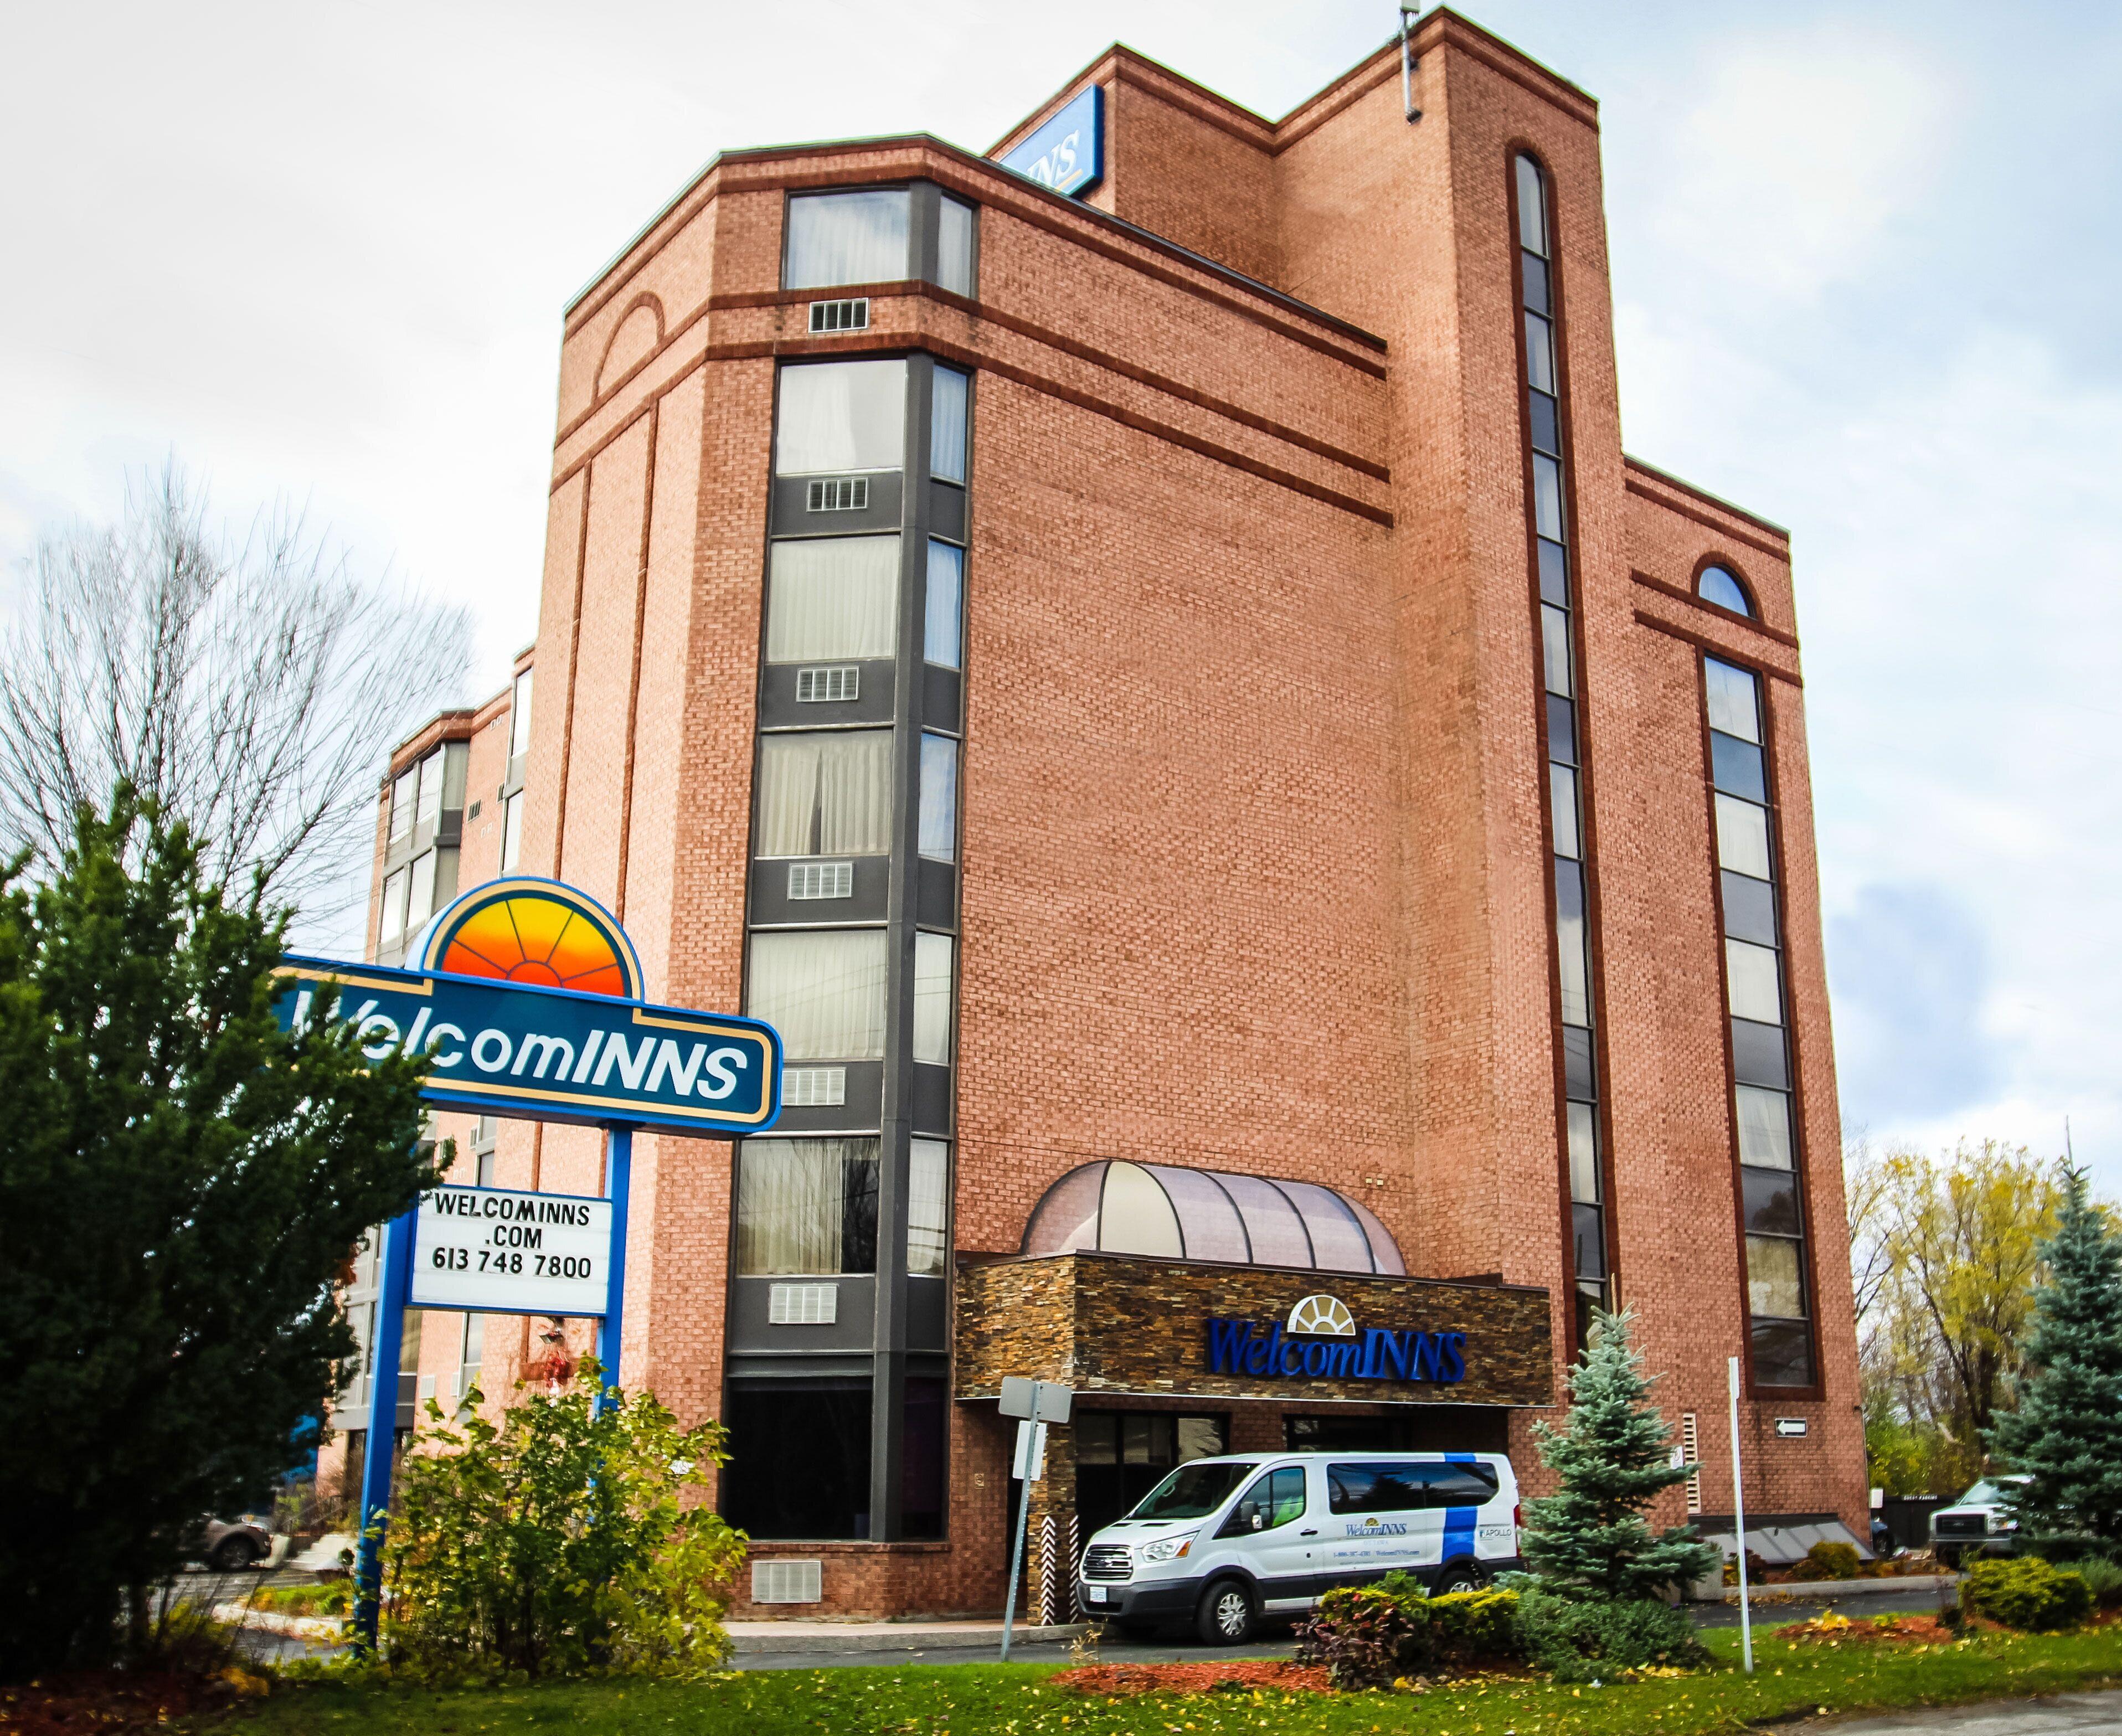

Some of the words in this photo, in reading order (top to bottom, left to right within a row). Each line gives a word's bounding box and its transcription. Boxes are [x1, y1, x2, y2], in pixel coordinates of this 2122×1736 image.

[434, 1192, 590, 1226] WELCOMINNS
[485, 1225, 542, 1249] .COM
[432, 1247, 468, 1270] 613
[478, 1250, 522, 1274] 748
[534, 1254, 591, 1279] 7800
[1206, 1318, 1466, 1383] WelcomINNS
[1346, 1523, 1407, 1537] WelcomINNS
